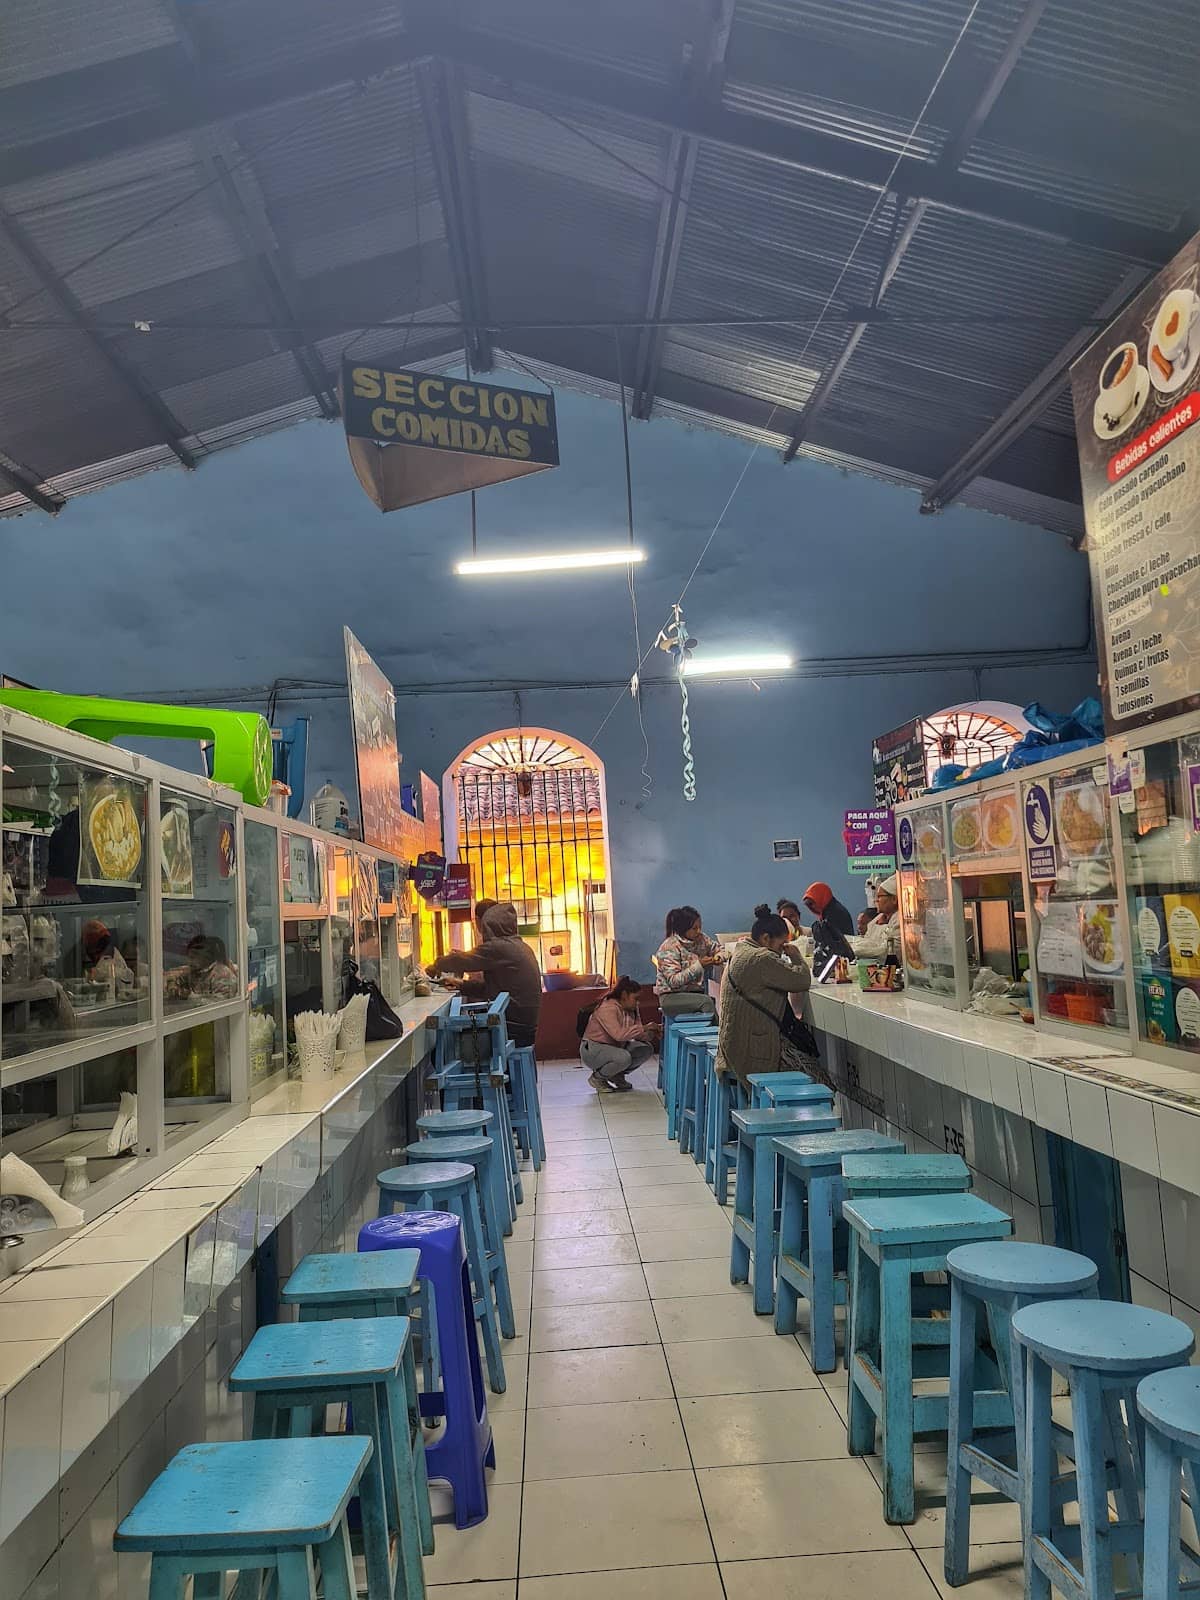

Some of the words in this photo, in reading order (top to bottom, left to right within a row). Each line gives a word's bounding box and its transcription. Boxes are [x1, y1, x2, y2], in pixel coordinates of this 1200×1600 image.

[352, 367, 549, 426] SECCION
[371, 407, 532, 458] COMIDAS
[1115, 441, 1148, 474] Bebidas
[1149, 405, 1192, 447] calientes
[1139, 453, 1169, 483] cargado
[1140, 461, 1186, 501] ayacuchano
[1106, 569, 1140, 596] Chocolate
[1149, 551, 1170, 572] leche
[1142, 577, 1159, 596] puro
[1111, 629, 1131, 647] Avena
[1113, 646, 1133, 664] Avena
[1142, 633, 1163, 651] leche
[1120, 676, 1150, 696] semillas
[1117, 693, 1154, 715] Infusiones
[847, 812, 868, 820] PAGA
[852, 822, 868, 830] CON
[867, 832, 889, 850] yape
